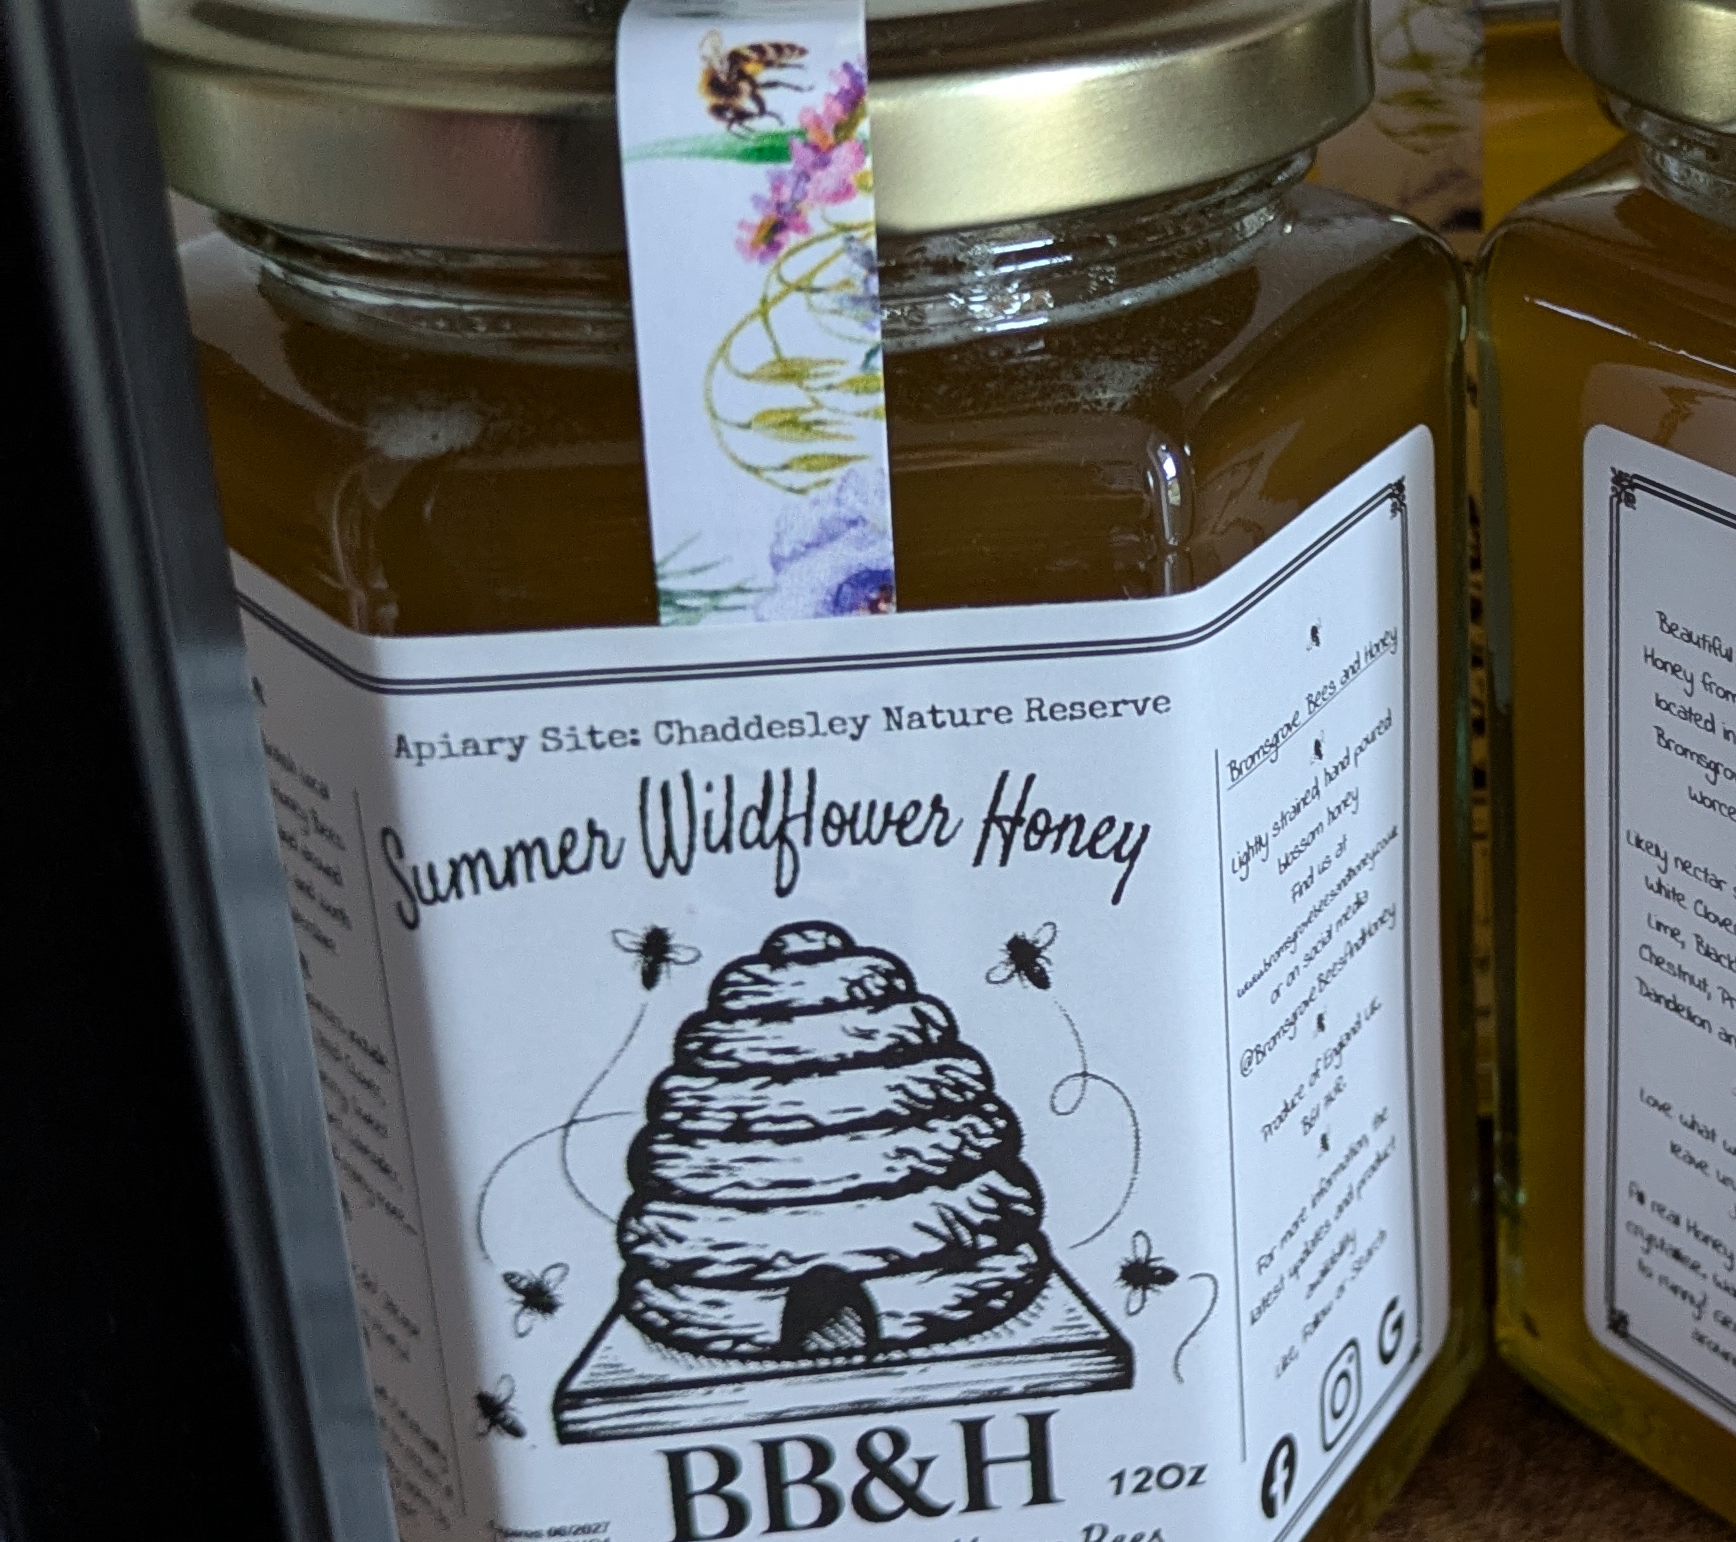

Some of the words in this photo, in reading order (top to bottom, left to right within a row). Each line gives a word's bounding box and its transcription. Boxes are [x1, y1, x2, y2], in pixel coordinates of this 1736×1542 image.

[1656, 611, 1732, 662] Beautiful
[1643, 645, 1694, 697] Honey
[394, 732, 527, 767] Apiary
[540, 725, 641, 753] Site:
[654, 711, 871, 746] Chaddesley
[882, 704, 1013, 732] Nature
[1024, 693, 1172, 723] Reserve
[1226, 710, 1300, 782] Bromsgrove
[1305, 679, 1336, 715] Bees
[1340, 651, 1362, 687] and
[1364, 626, 1398, 664] Honey
[1655, 693, 1715, 734] located
[1722, 722, 1736, 744] in
[1231, 831, 1269, 882] Lightly
[1324, 746, 1350, 787] hand
[1353, 707, 1392, 769] poured
[381, 817, 626, 931] Summer
[639, 766, 964, 898] Wildflower
[972, 768, 1151, 906] Honey
[1277, 821, 1323, 875] blossom
[1326, 786, 1359, 826] honey
[1317, 855, 1332, 875] us
[1335, 833, 1347, 858] at
[1626, 829, 1668, 874] Likely
[1674, 856, 1727, 891] nectar
[1270, 982, 1283, 1005] or
[1286, 965, 1301, 987] on
[1303, 923, 1333, 968] social
[1335, 890, 1369, 932] media
[1648, 912, 1685, 949] Lime,
[1639, 944, 1711, 1000] Chestnut,
[1635, 976, 1712, 1033] Dandelion
[1261, 1083, 1305, 1143] Produce
[1309, 1057, 1322, 1088] of
